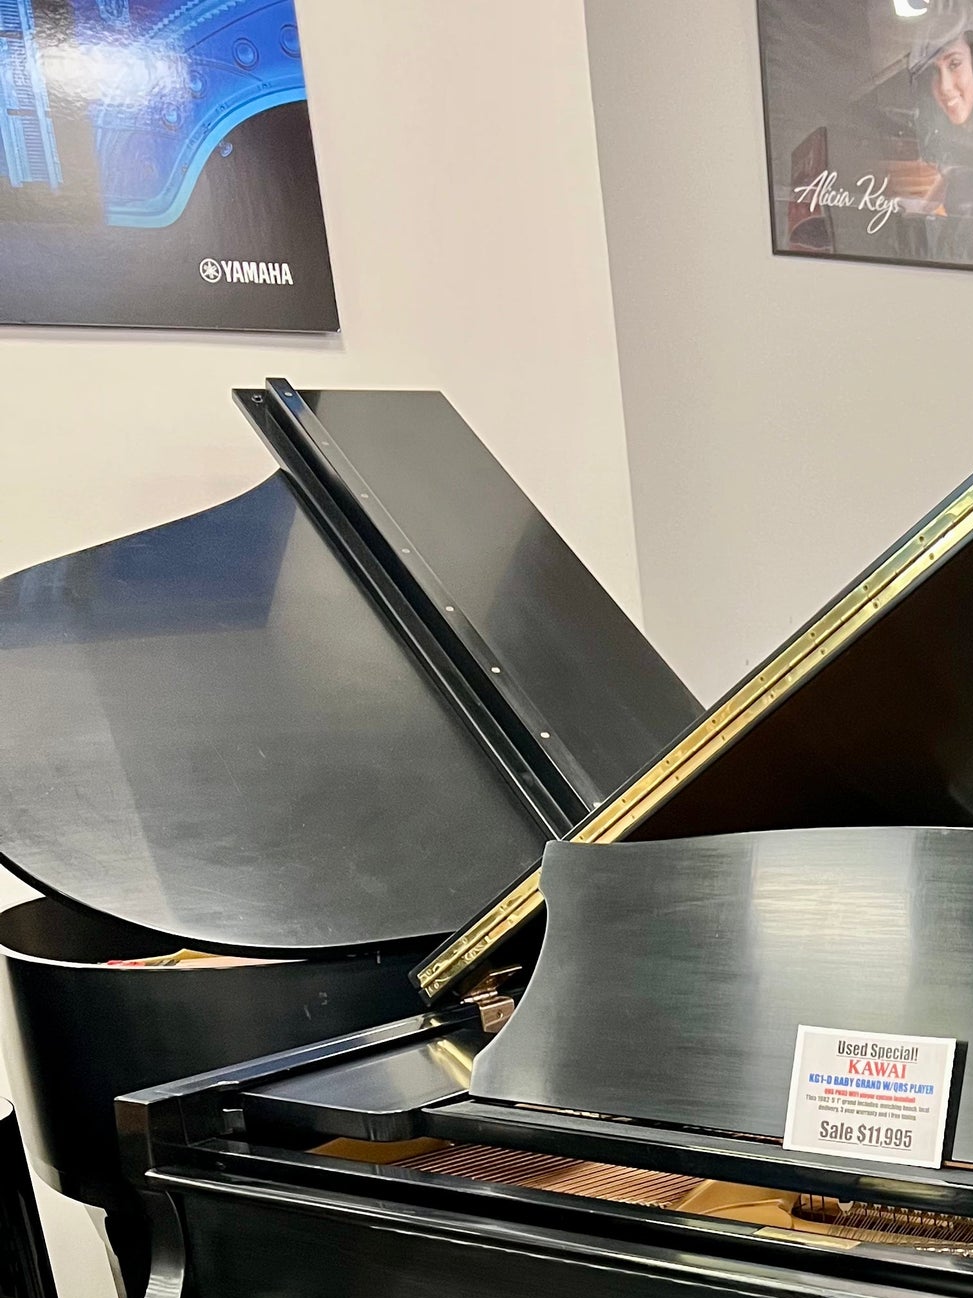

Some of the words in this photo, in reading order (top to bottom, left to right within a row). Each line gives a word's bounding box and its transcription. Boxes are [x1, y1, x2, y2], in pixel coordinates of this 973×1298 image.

[794, 170, 855, 213] Alicia
[856, 174, 901, 234] Keys
[221, 260, 293, 285] YAMAHA
[837, 1040, 867, 1057] Used
[870, 1043, 919, 1061] Special!
[848, 1059, 907, 1079] KAWAI
[808, 1073, 832, 1085] KG1-D
[833, 1075, 855, 1088] BABY
[855, 1078, 881, 1090] GRAND
[882, 1080, 908, 1093] W/QRS
[909, 1083, 934, 1095] PLAYER
[819, 1120, 853, 1141] Sale
[856, 1123, 912, 1148] $11,995
